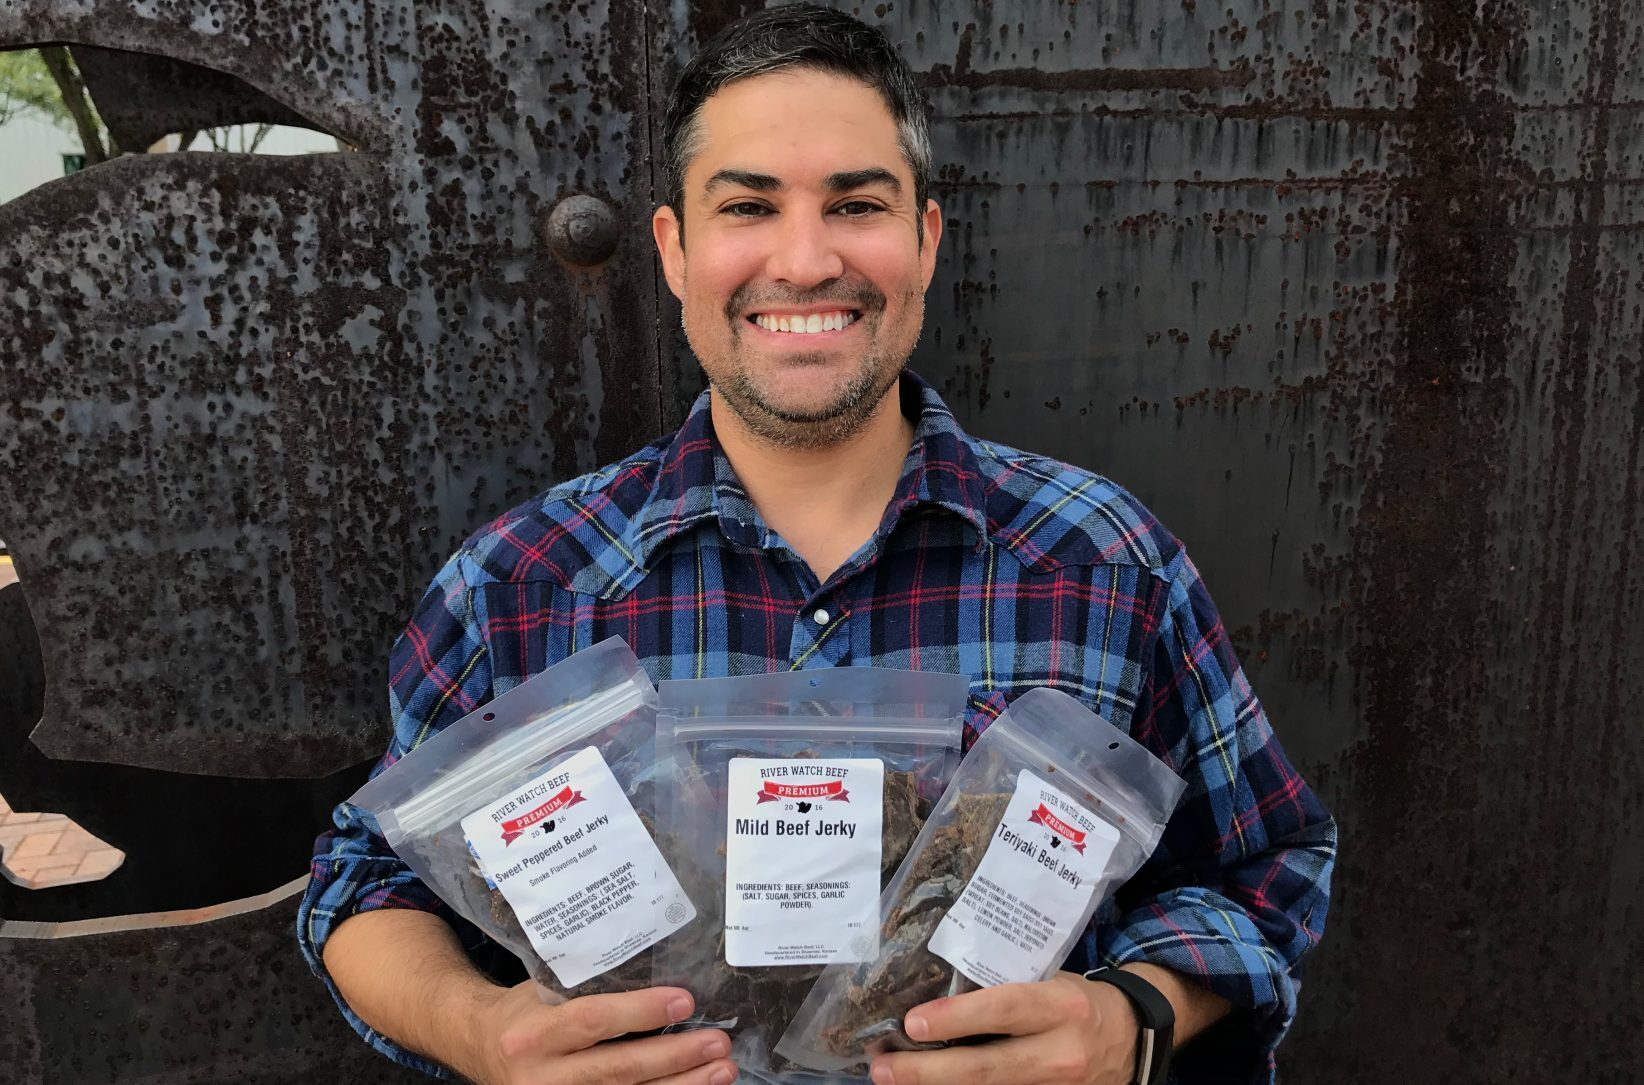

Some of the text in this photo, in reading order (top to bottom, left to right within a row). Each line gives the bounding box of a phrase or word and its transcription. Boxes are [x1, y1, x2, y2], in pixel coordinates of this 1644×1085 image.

[760, 766, 848, 778] RIVER WATCH BEEF
[492, 772, 571, 822] RIVER WATCH BEEF
[778, 786, 828, 795] PREMIUM
[516, 798, 562, 827] PREMIUM
[1040, 790, 1095, 832] RIVER WATCH BEEF
[1045, 814, 1075, 840] PREMIUM
[736, 819, 856, 838] Mild Beef Jerky
[496, 814, 609, 882] Sweet Peppered Beef Jerky
[998, 824, 1082, 889] Teriyaki Beef Jerky
[530, 845, 597, 886] Smoke Flavoring Added
[525, 902, 568, 927] INGREDIENTS:
[586, 876, 610, 893] BROWN
[558, 894, 599, 919] SEASONINGS:
[603, 883, 616, 894] SEA
[806, 882, 850, 890] SEASONINGS:
[591, 897, 612, 911] BLACK
[556, 922, 585, 940] NATURAL
[585, 908, 608, 925] SMOKE
